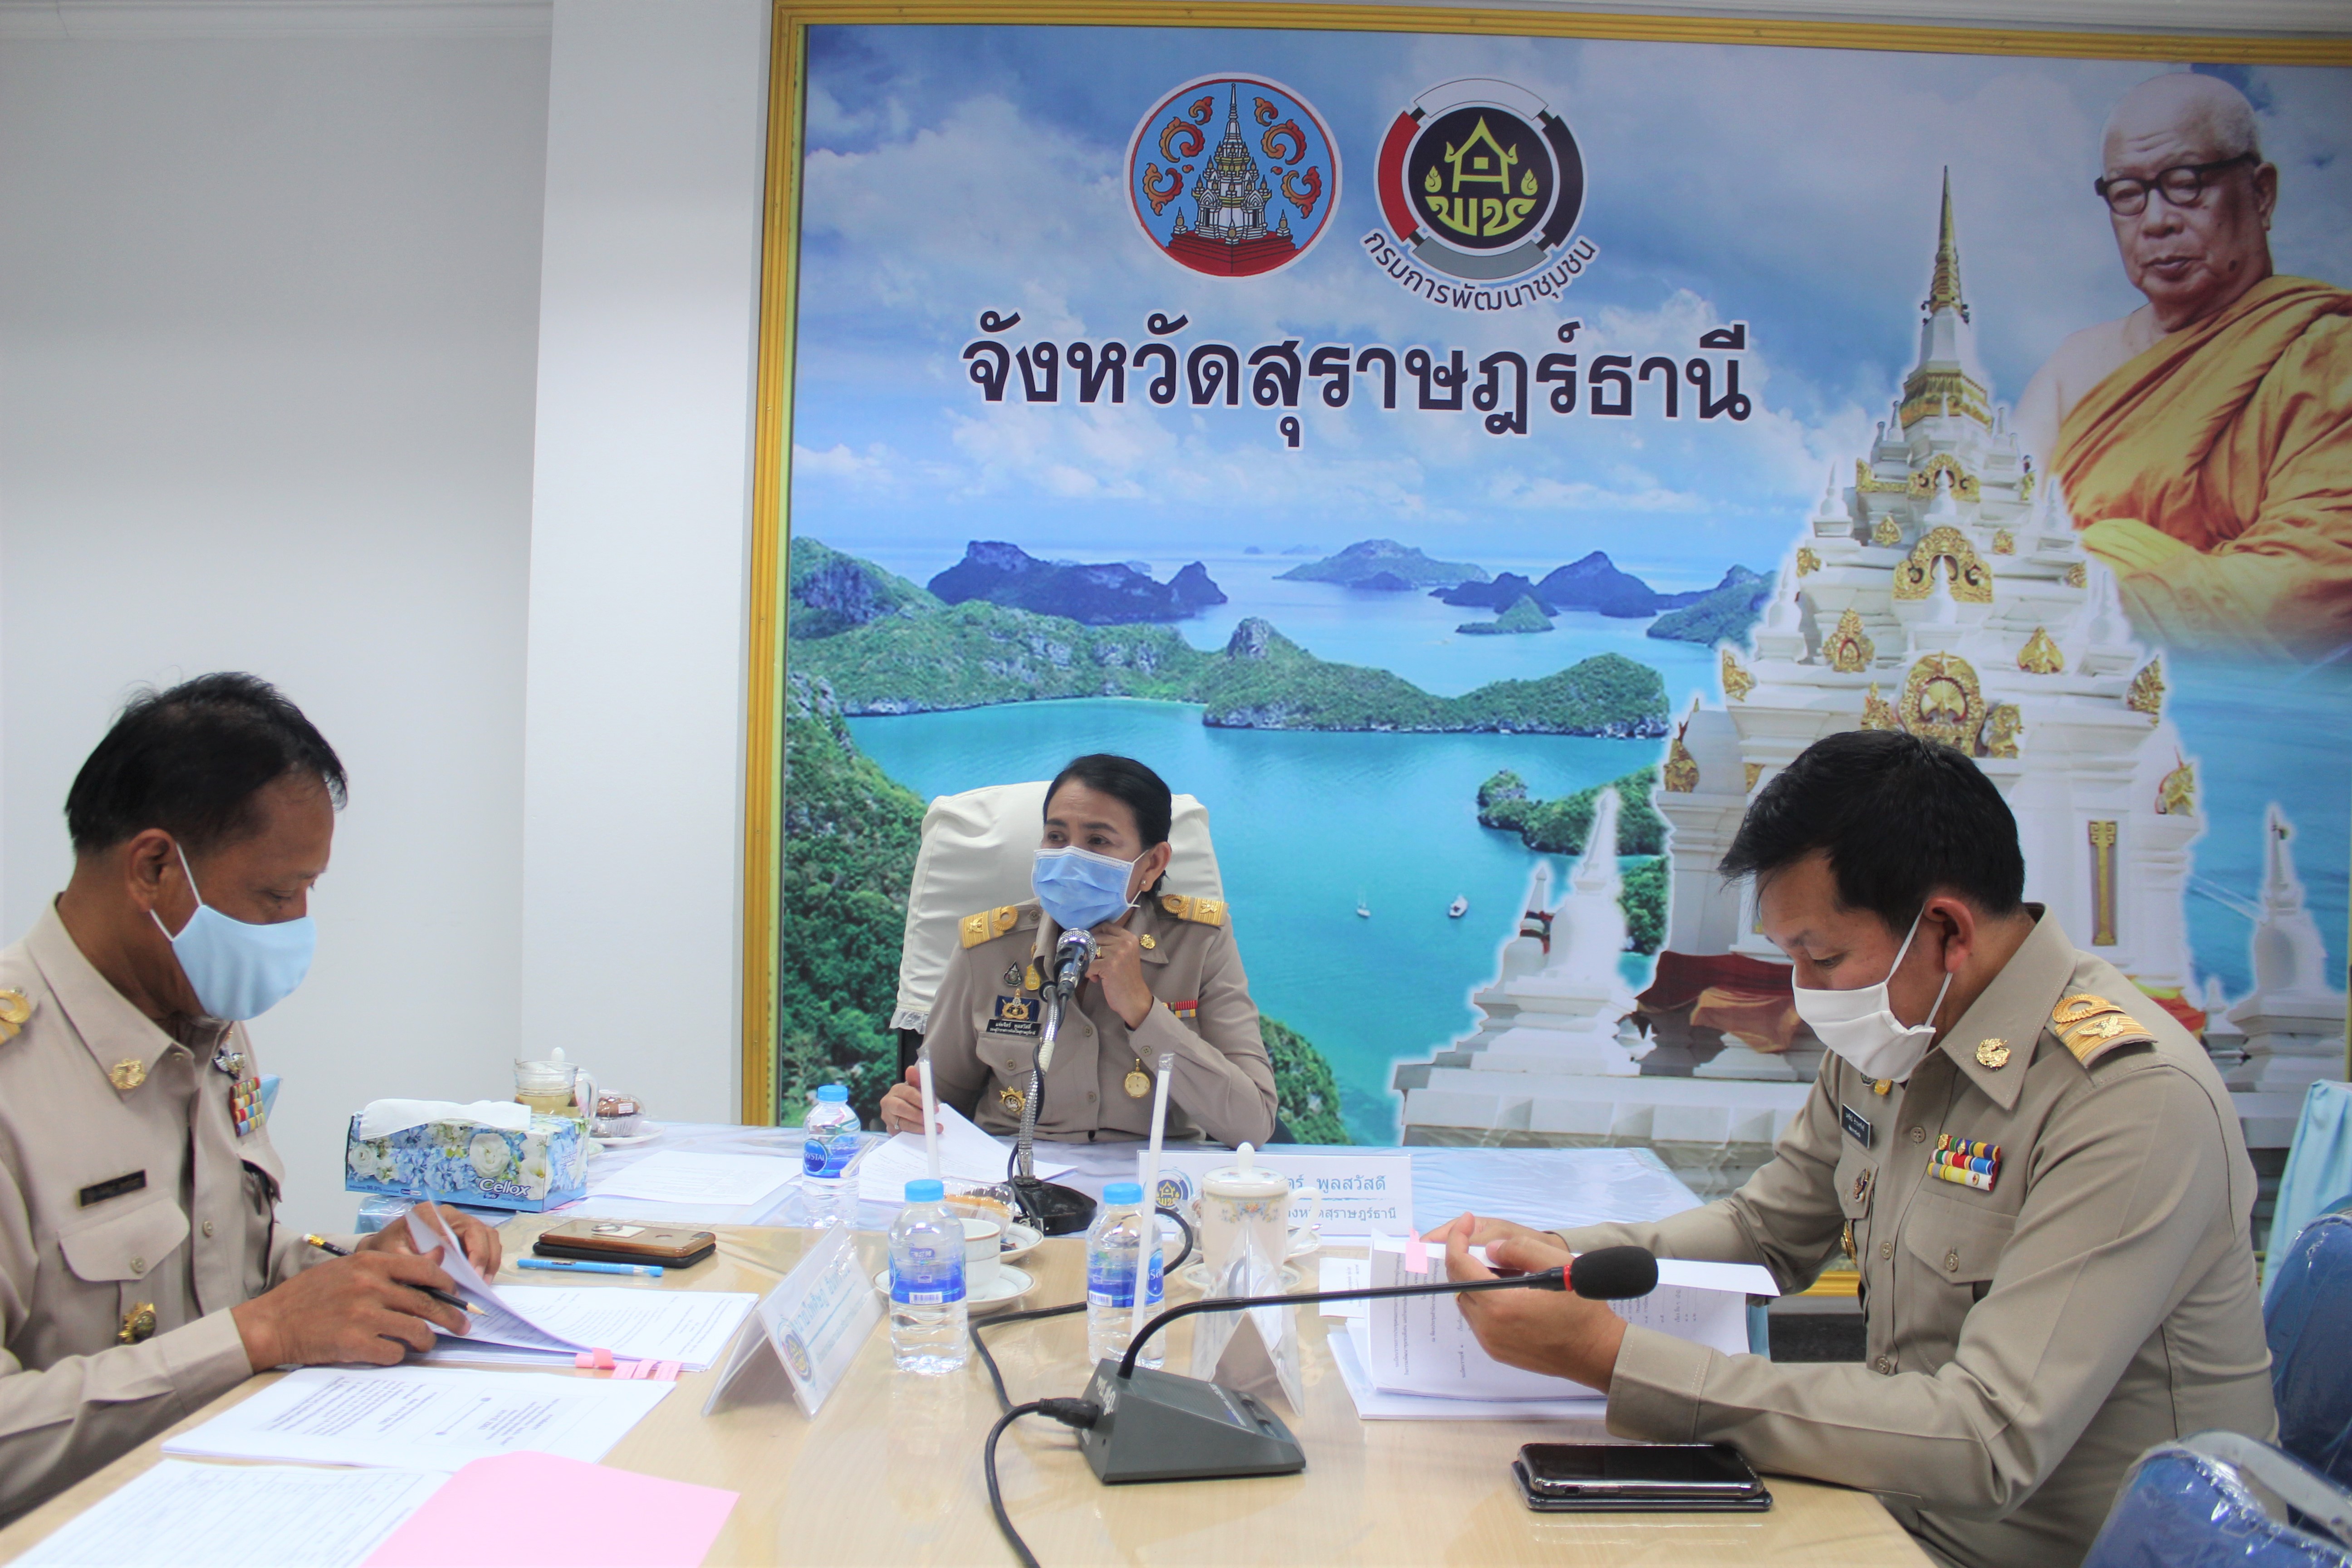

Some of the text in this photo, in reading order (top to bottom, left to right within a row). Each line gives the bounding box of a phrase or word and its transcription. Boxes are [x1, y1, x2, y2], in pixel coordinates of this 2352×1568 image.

[1364, 232, 1596, 310] กรมการพัฒนาชุมชน
[964, 311, 1750, 446] จังหวัดสุราษฎร์ธานี
[479, 1178, 531, 1196] Cellox
